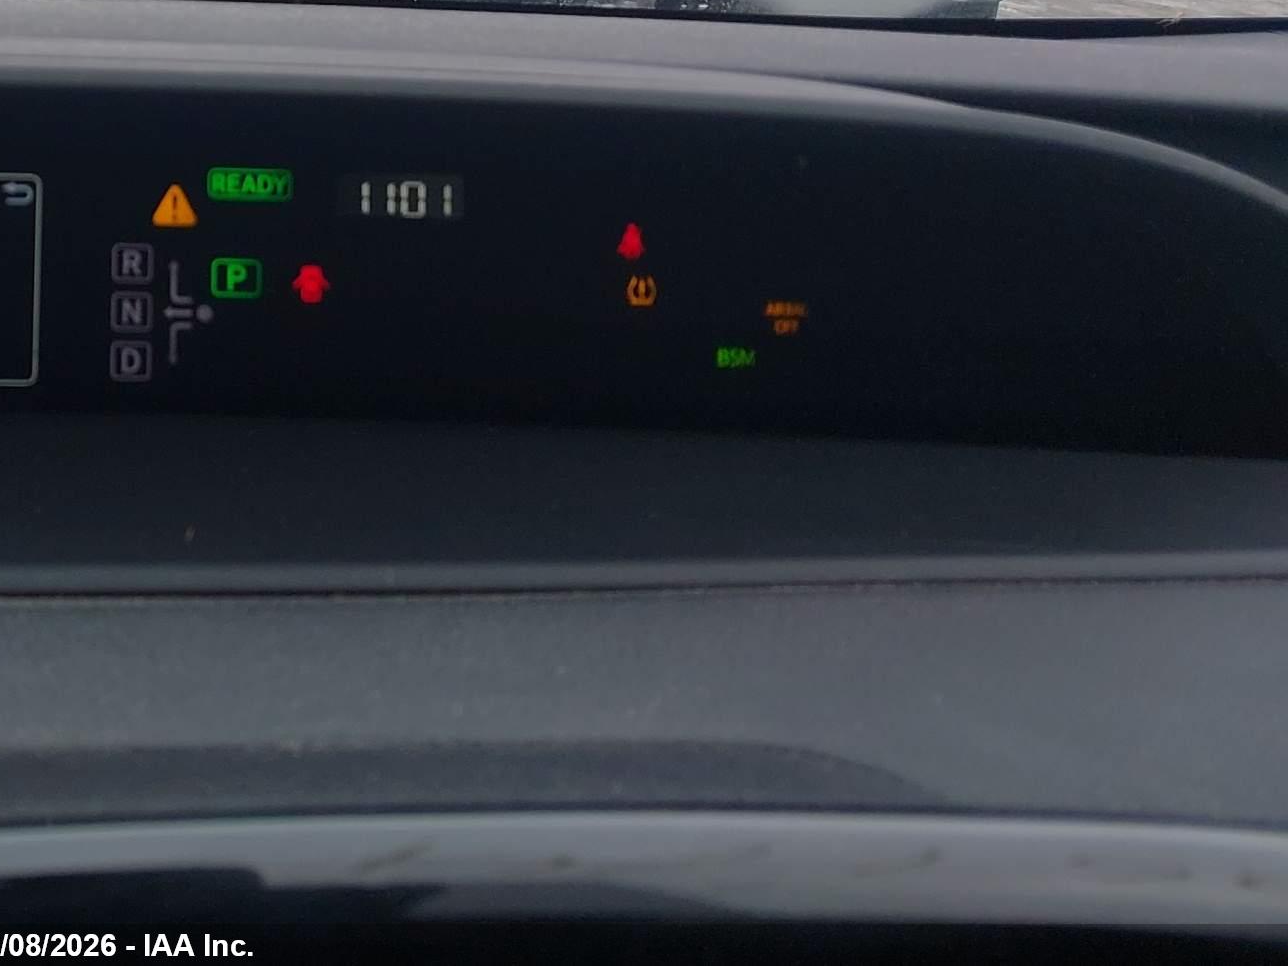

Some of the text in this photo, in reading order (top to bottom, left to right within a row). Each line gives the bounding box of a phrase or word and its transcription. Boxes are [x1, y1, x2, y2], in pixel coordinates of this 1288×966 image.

[211, 172, 289, 194] READY
[121, 249, 142, 276] R
[225, 264, 247, 291] P
[121, 299, 142, 323] N
[120, 347, 142, 374] D
[716, 347, 756, 368] BSM
